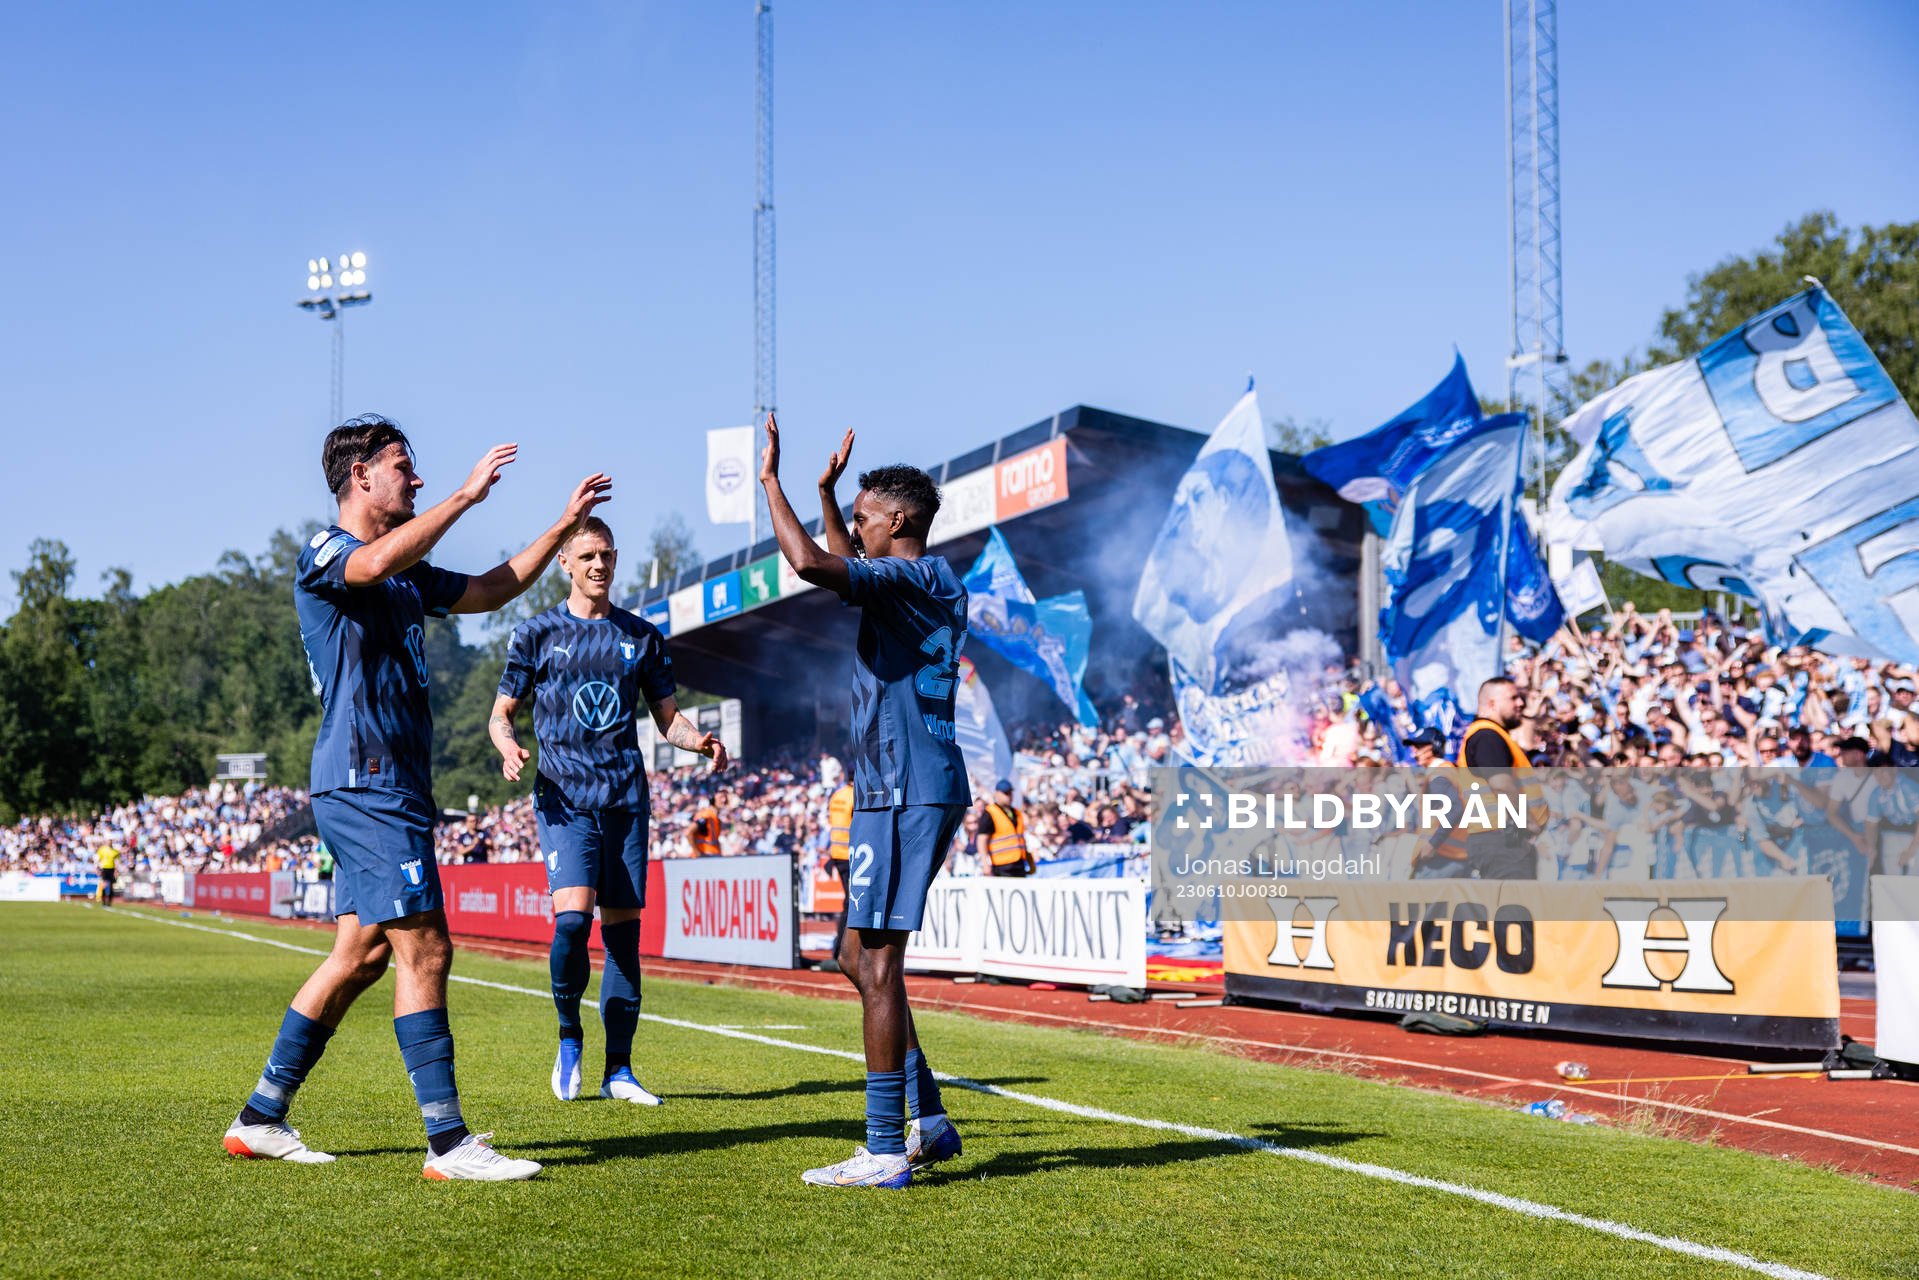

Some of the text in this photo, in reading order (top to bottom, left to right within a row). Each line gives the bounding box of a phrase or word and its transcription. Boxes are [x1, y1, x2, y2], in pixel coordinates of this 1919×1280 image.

[573, 681, 620, 731] VW
[682, 878, 779, 942] SANDAHLS
[983, 888, 1130, 960] NOMINIT
[1386, 902, 1535, 975] HECO
[1365, 990, 1551, 1025] SKRUVSPECIALISTEN
